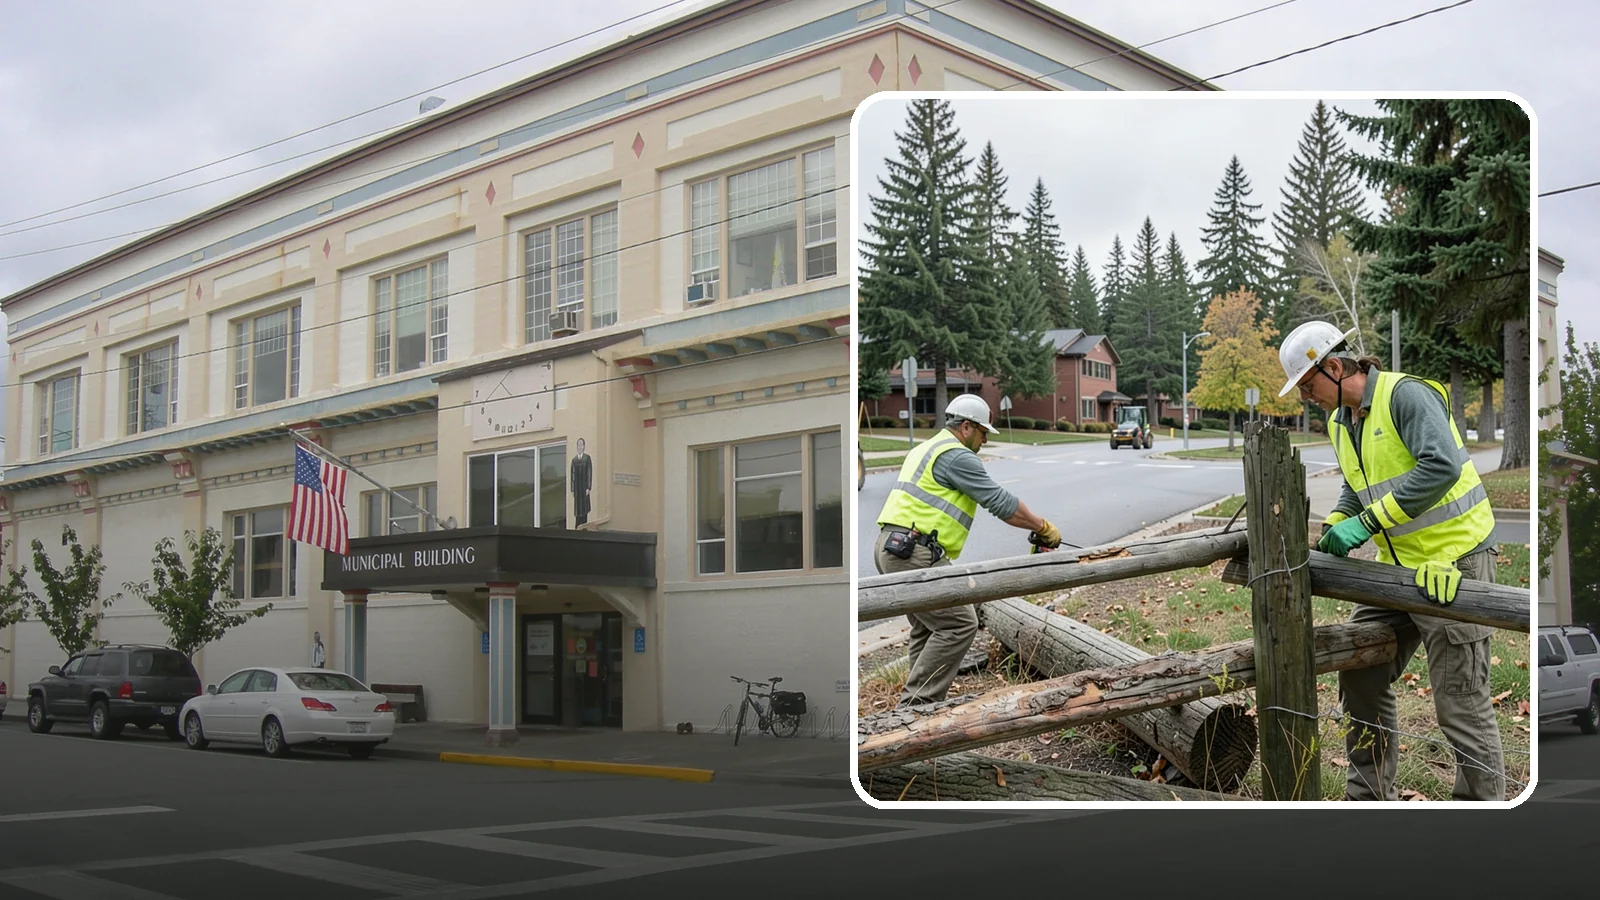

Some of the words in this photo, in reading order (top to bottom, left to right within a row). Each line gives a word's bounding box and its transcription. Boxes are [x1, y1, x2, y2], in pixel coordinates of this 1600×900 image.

[475, 390, 479, 398] 7
[536, 402, 540, 410] 4
[480, 407, 485, 415] 8
[487, 417, 492, 425] 9
[529, 413, 533, 422] 3
[494, 423, 500, 431] 10
[521, 420, 525, 428] 2
[501, 425, 506, 433] 11
[507, 425, 513, 433] 12
[342, 552, 405, 572] MUNICIPAL
[414, 546, 475, 567] BUILDING
